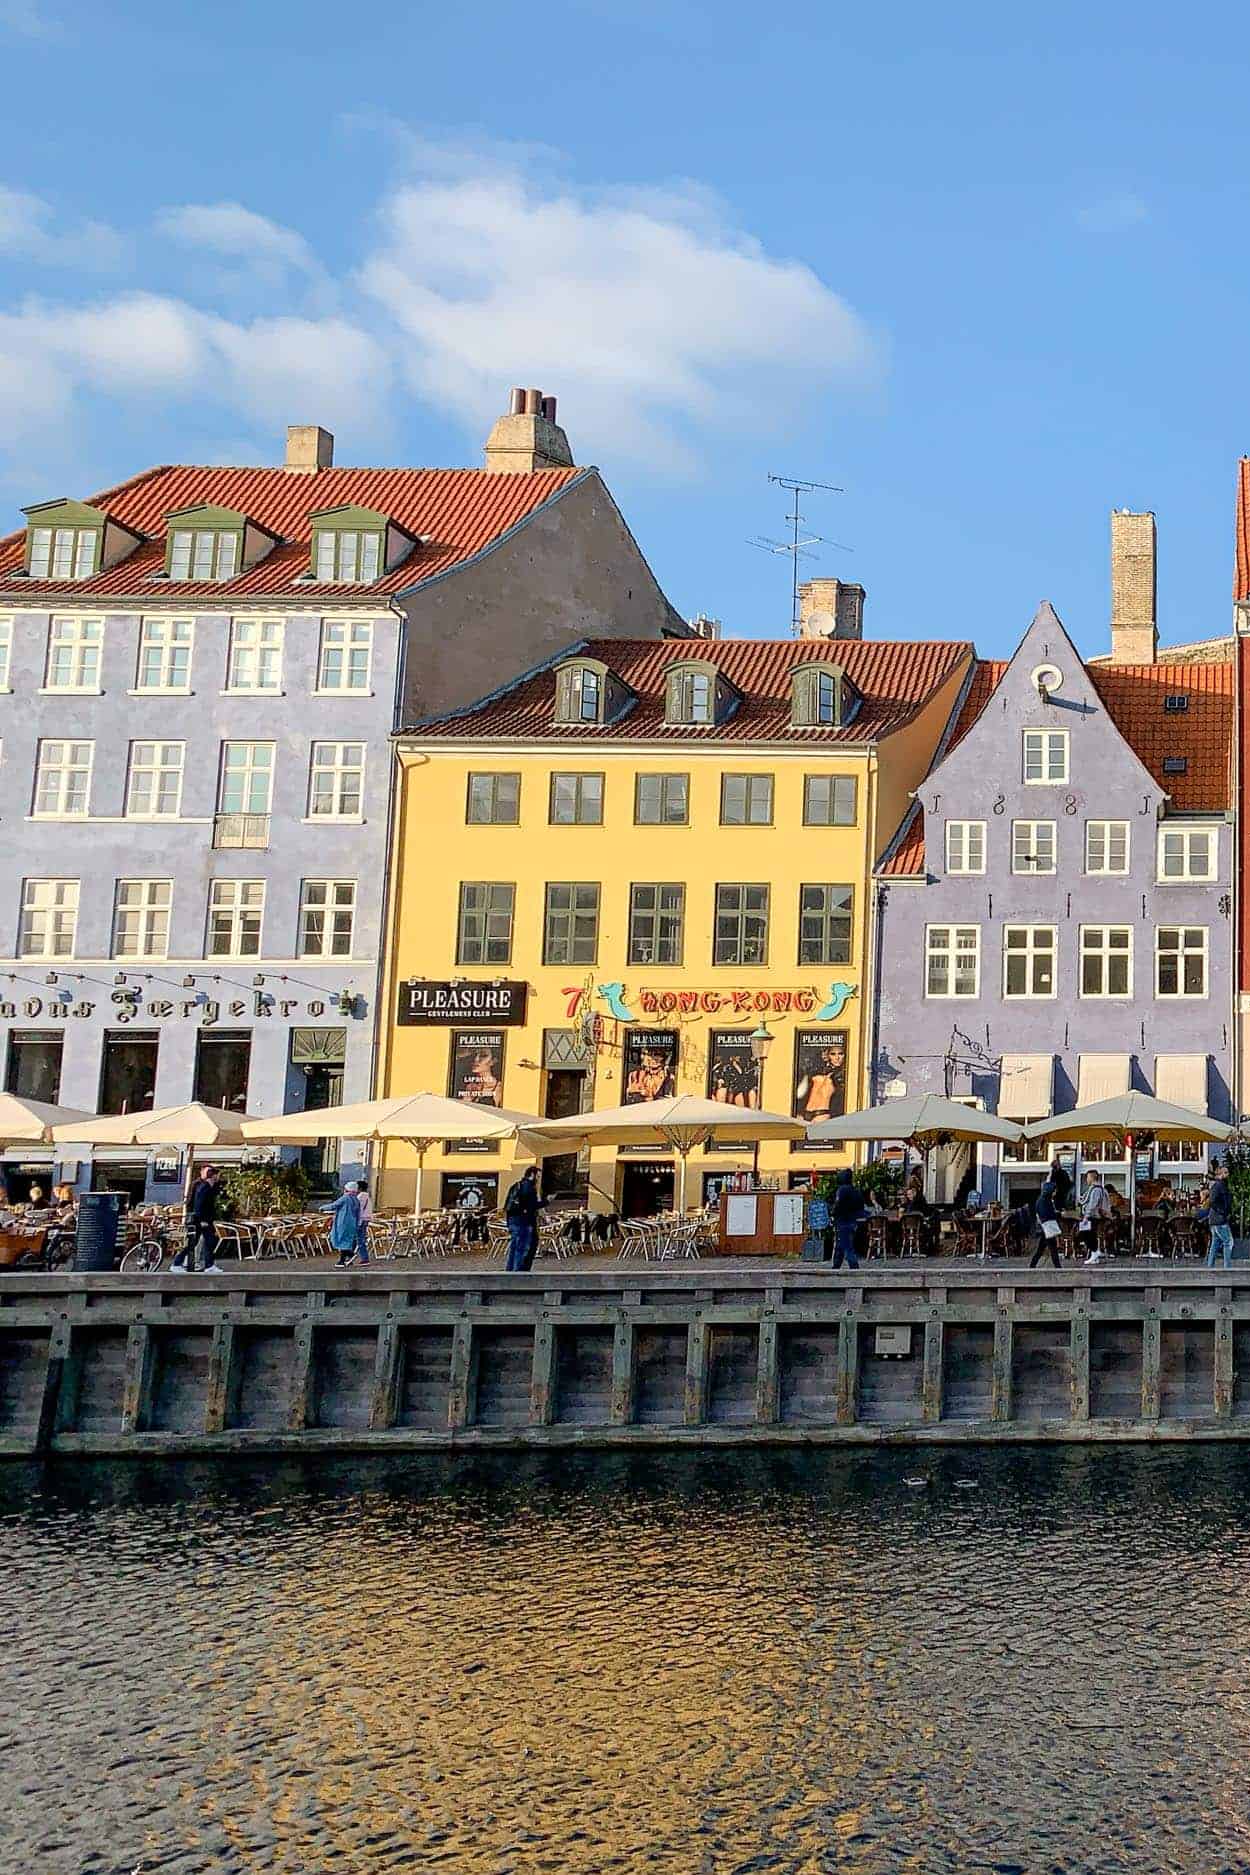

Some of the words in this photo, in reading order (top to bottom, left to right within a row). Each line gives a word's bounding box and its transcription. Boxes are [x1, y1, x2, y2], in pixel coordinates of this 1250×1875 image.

[410, 990, 511, 1008] PLEASURE
[459, 1036, 501, 1044] PLEASURE
[632, 1036, 673, 1044] PLEASURE
[802, 1035, 844, 1043] PLEASURE
